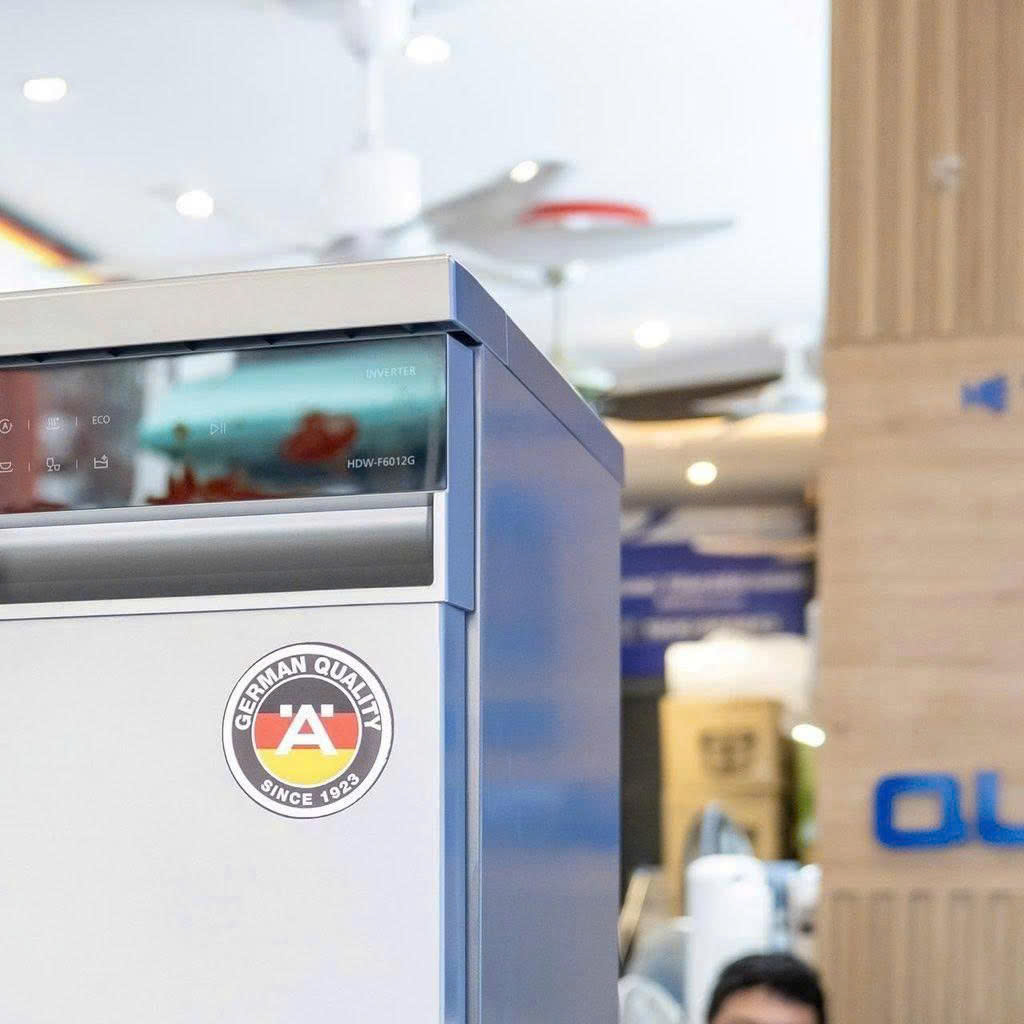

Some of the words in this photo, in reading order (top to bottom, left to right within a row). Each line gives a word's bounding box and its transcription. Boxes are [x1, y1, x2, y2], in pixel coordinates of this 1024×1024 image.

[366, 366, 417, 379] INVERTER
[92, 414, 111, 425] ECO
[347, 455, 416, 469] HDW-F6012G
[234, 656, 307, 731] GERMAN
[314, 656, 382, 731] QUALITY
[260, 779, 313, 806] SINCE
[320, 773, 360, 803] 1923
